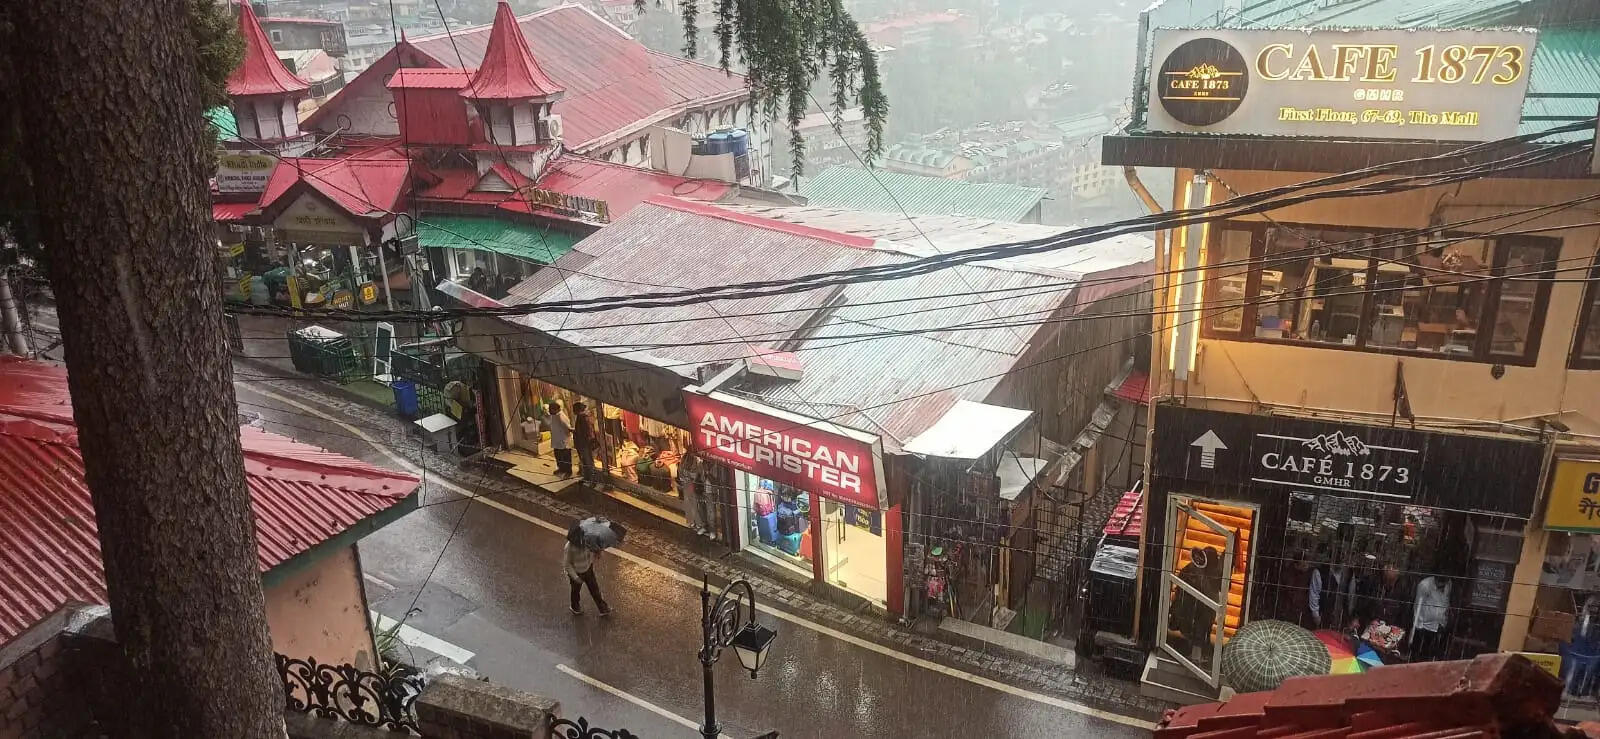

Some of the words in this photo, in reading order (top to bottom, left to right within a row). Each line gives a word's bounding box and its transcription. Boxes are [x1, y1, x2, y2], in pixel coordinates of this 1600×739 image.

[1255, 43, 1398, 82] CAFE
[1411, 44, 1524, 85] 1873
[1170, 79, 1200, 89] CAFE
[1202, 80, 1229, 90] 1873
[1353, 88, 1404, 101] GMHR
[1278, 106, 1314, 121] First
[1314, 107, 1358, 124] Floor,
[1360, 109, 1405, 126] 67-69,
[1408, 110, 1438, 125] The
[1439, 110, 1479, 126] Mall
[700, 411, 860, 474] AMERICAN
[700, 428, 862, 494] TOURISTER
[1261, 452, 1333, 477] CAFÉ
[1344, 461, 1410, 485] 1873
[1313, 475, 1351, 488] GMHR
